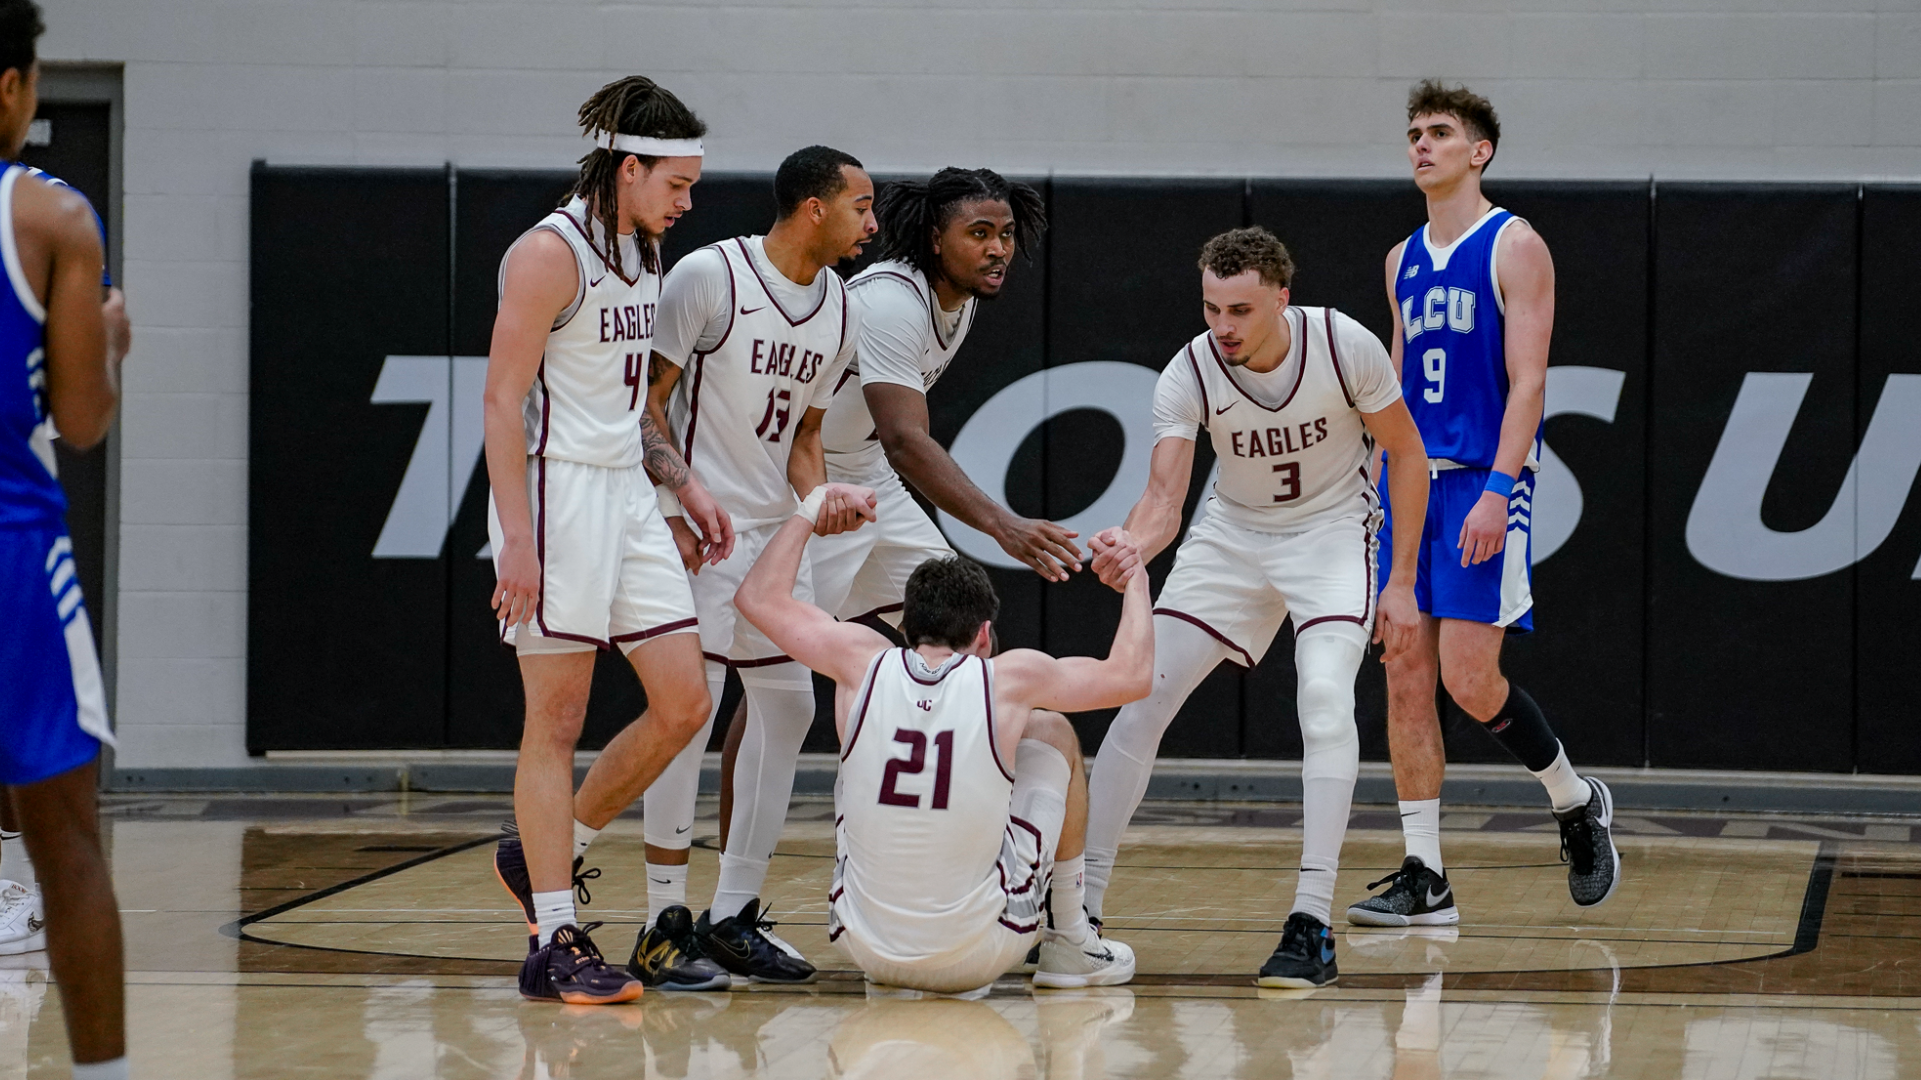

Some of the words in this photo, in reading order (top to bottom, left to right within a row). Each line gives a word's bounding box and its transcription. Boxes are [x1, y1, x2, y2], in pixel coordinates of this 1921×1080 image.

[1401, 286, 1476, 344] LCU
[623, 352, 643, 412] 4
[750, 338, 823, 384] EAGLES
[1422, 348, 1446, 404] 9
[1231, 416, 1328, 459] EAGLES
[1272, 461, 1302, 503] 3
[877, 726, 956, 811] 21
